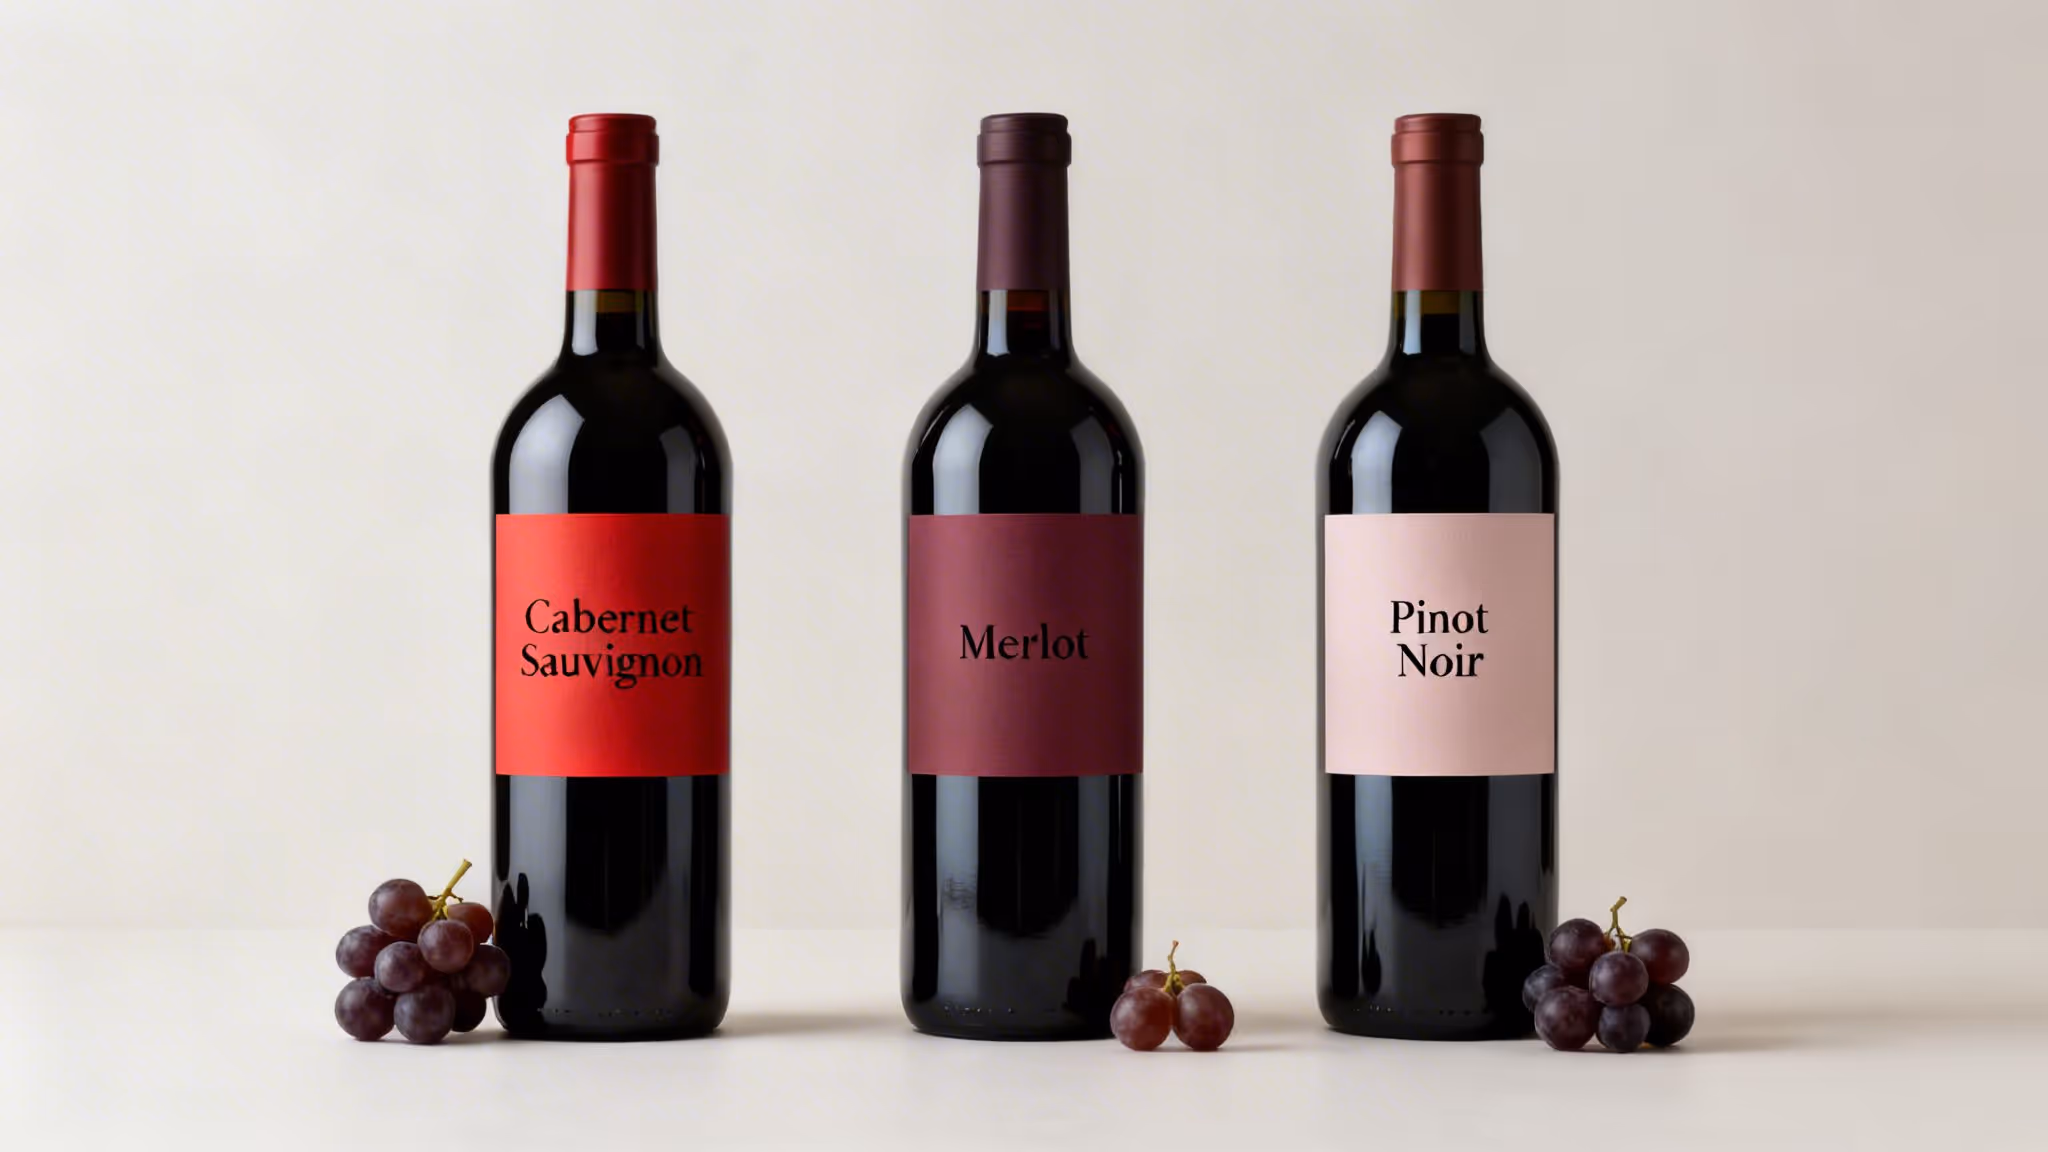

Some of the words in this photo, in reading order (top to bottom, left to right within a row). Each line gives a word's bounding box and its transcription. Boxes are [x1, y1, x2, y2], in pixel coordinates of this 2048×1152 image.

[524, 598, 695, 635] Cabernet
[1390, 599, 1489, 634] Pinot
[960, 623, 1090, 660] Merlot
[521, 643, 704, 690] Sauvignon
[1397, 643, 1485, 678] Noir
